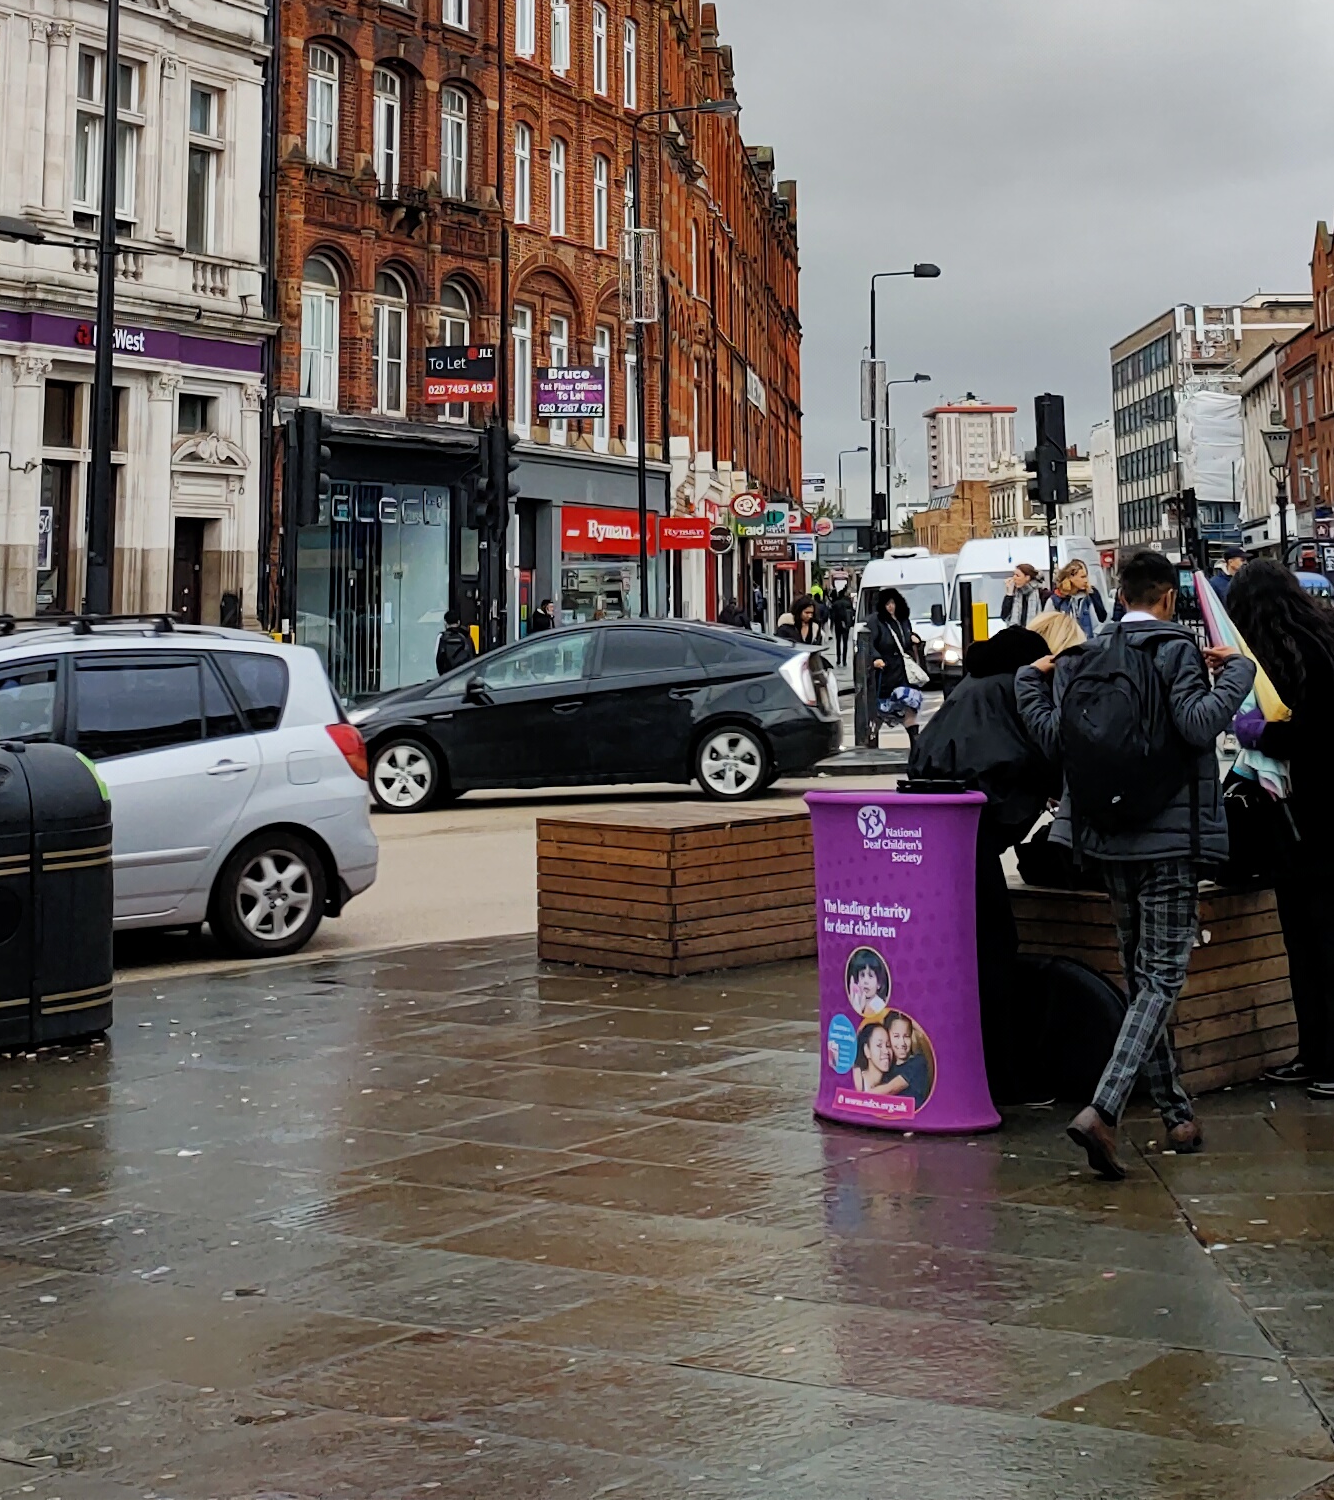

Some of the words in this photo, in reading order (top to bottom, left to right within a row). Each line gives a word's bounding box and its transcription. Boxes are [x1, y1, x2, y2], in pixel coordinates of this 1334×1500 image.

[428, 358, 444, 370] To
[447, 357, 467, 370] Let
[548, 368, 590, 380] Bruce
[428, 385, 446, 395] 020
[554, 382, 573, 391] Floor
[574, 382, 602, 391] Offices
[557, 391, 570, 400] To
[572, 391, 585, 401] Let
[539, 403, 555, 413] 020
[587, 519, 631, 542] Ryman
[664, 528, 704, 537] Ryman
[738, 523, 765, 536] traid
[886, 827, 922, 838] National
[863, 839, 881, 849] Deaf
[882, 838, 923, 850] Children's
[891, 852, 923, 865] Society
[824, 899, 836, 913] The
[837, 899, 870, 920] leading
[871, 902, 911, 923] charity
[824, 917, 834, 933] for
[835, 918, 854, 935] deaf
[854, 921, 896, 938] children
